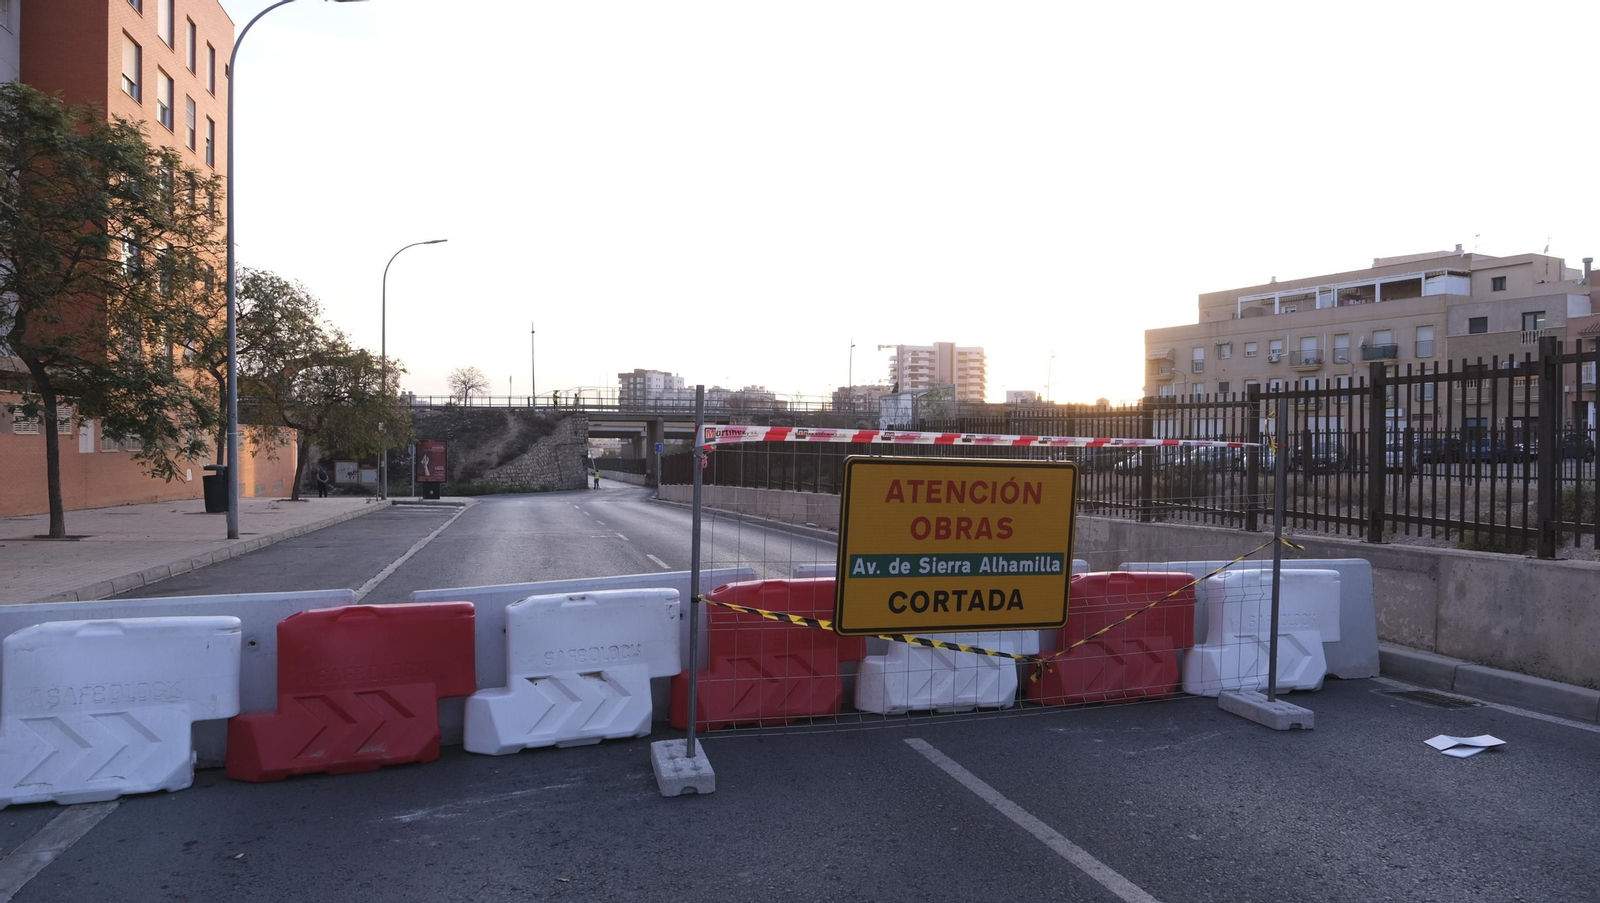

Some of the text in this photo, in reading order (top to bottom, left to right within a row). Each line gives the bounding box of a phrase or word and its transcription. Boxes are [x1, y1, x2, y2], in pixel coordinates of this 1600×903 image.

[885, 477, 1042, 504] ATENCIÓN
[910, 516, 1014, 540] OBRAS
[852, 556, 1061, 575] Av. de Sierra Alhamilla
[888, 588, 1024, 614] CORTADA
